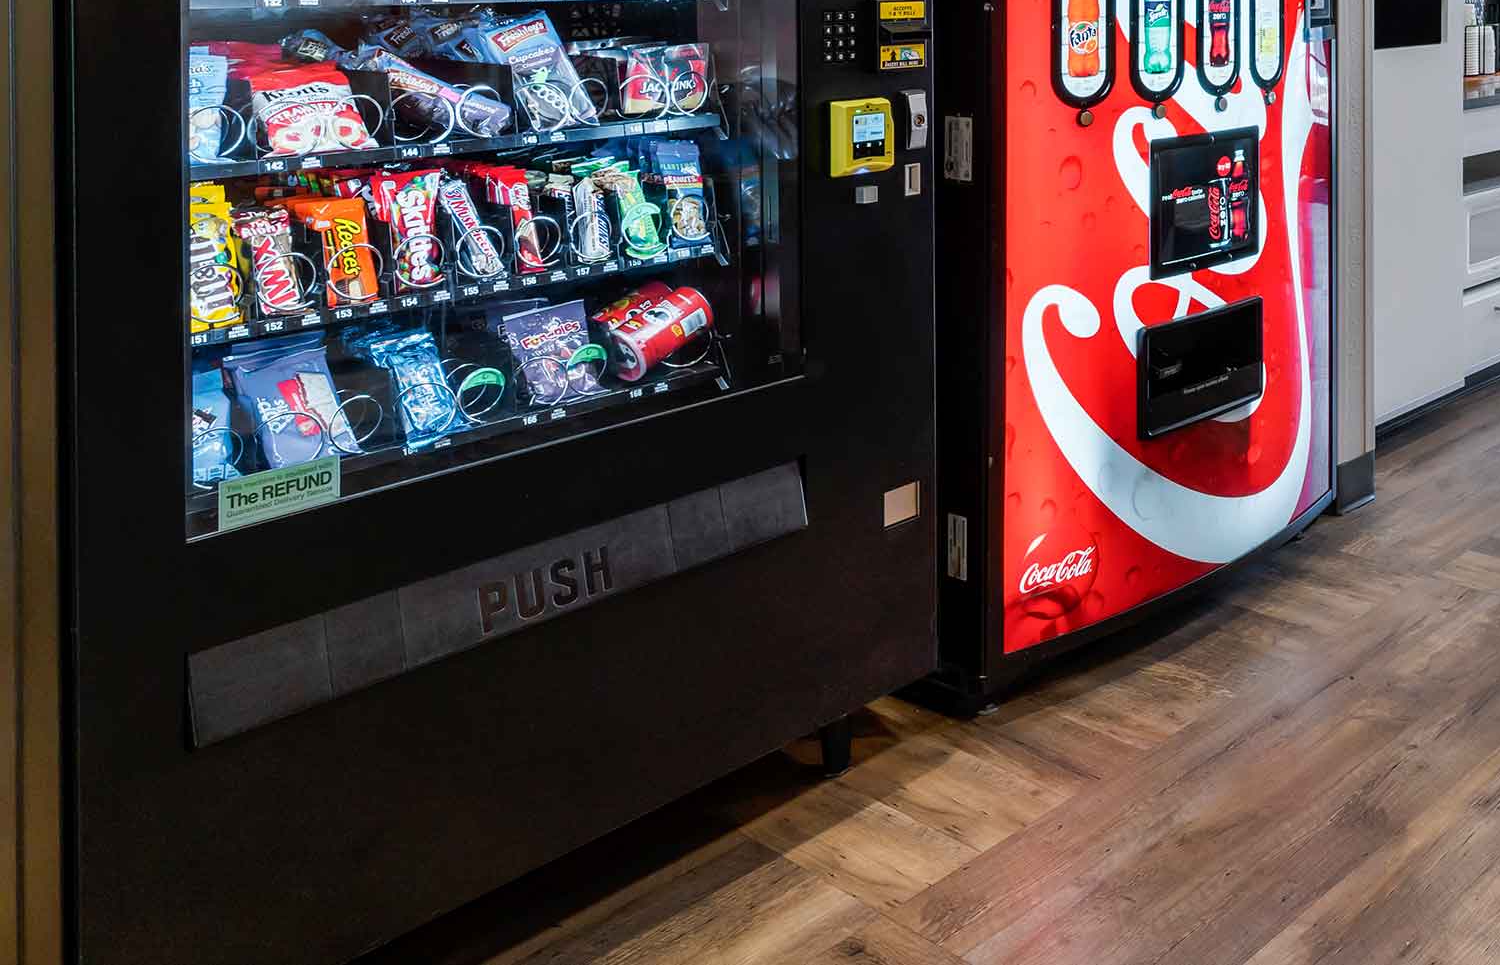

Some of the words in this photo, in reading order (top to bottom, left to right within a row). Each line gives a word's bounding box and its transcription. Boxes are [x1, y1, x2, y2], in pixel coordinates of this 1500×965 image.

[508, 46, 555, 65] Cupcakes
[401, 146, 419, 157] 144
[264, 161, 284, 171] 142
[396, 190, 433, 281] Skittles
[333, 217, 361, 276] Reese's
[576, 266, 591, 276] 157
[463, 286, 479, 297] 155
[401, 297, 419, 307] 154
[335, 308, 353, 319] 153
[264, 320, 284, 331] 152
[226, 492, 258, 508] The
[262, 471, 332, 501] REFUND
[477, 546, 613, 636] PUSH
